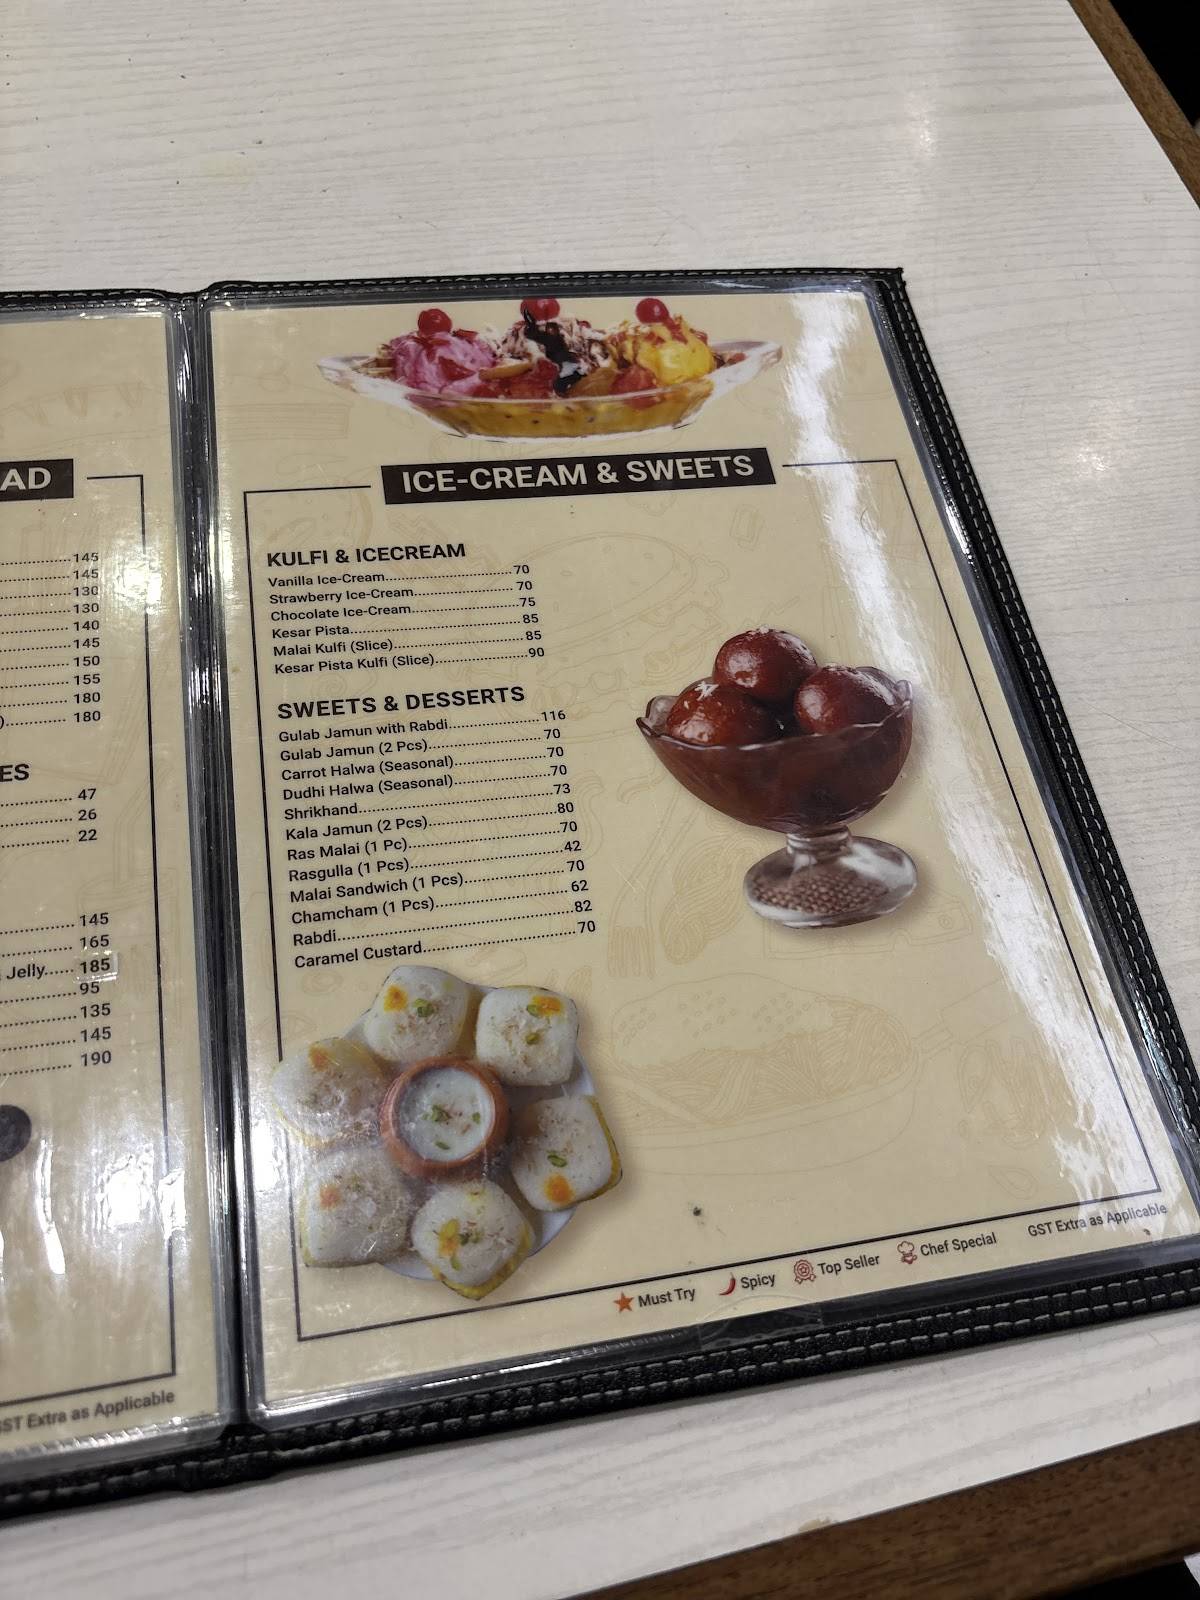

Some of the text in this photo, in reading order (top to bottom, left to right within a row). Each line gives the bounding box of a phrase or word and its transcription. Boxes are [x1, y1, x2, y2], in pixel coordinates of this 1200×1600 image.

[0, 467, 51, 491] AD
[402, 455, 755, 494] ICE-CREAM & SWEETS
[73, 553, 98, 562] 145
[267, 543, 466, 567] KULFI & ICECREAM
[73, 569, 98, 579] 145
[268, 565, 529, 587] Vanilla Ice-Cream 70
[73, 587, 98, 597] 130
[270, 581, 533, 604] Strawberry Ice-Cream 70
[73, 604, 99, 613] 130
[271, 597, 536, 621] Chocolate Ice-Cream 75
[73, 620, 99, 631] 140
[272, 614, 539, 639] Kesar Pista 85
[73, 638, 100, 649] 145
[273, 631, 542, 656] Malai Kulfi (Slice) 85
[74, 656, 100, 666] 150
[275, 647, 545, 674] Kesar Pista Kulfi (Slice) 90
[74, 674, 100, 684] 155
[74, 692, 100, 703] 180
[277, 686, 525, 719] SWEETS & DESSERTS
[74, 711, 101, 722] 180
[279, 710, 566, 742] Gulab Jamun with Rabdi 116
[280, 729, 561, 762] Gulab Jamun (2 Pcs) 70
[0, 763, 30, 782] ES
[281, 747, 564, 781] Carrot Halwa (Seasonal) 70
[283, 765, 567, 800] Dudhi Halwa (Seasonal) 70
[78, 789, 96, 800] 47
[284, 784, 571, 820] Shrikhand 73
[78, 809, 97, 821] 26
[286, 803, 574, 840] Kala Jamun (2 Pcs) 80
[78, 829, 97, 842] 22
[287, 822, 578, 861] Ras Malai (1 Pc) 70
[289, 841, 582, 882] Rasgulla (1 Pcs) 42
[291, 860, 585, 903] Malai Sandwich (1 Pcs) 70
[291, 880, 589, 924] Chamcham (1 Pcs) 62
[80, 913, 109, 926] 145
[293, 901, 593, 947] Rabdi 82
[80, 935, 109, 948] 165
[295, 921, 596, 968] Caramel Custard 70
[6, 958, 110, 980] Jelly 185
[80, 982, 100, 994] 95
[80, 1004, 111, 1018] 135
[81, 1027, 112, 1042] 145
[81, 1051, 112, 1066] 190
[1028, 1203, 1167, 1237] GST Extra as Applicable
[920, 1232, 997, 1256] Chef Special
[817, 1252, 880, 1278] Top Seller
[741, 1273, 775, 1289] Spicy
[638, 1287, 695, 1307] Must Try
[0, 1390, 175, 1432] ST Extra as Applicable
